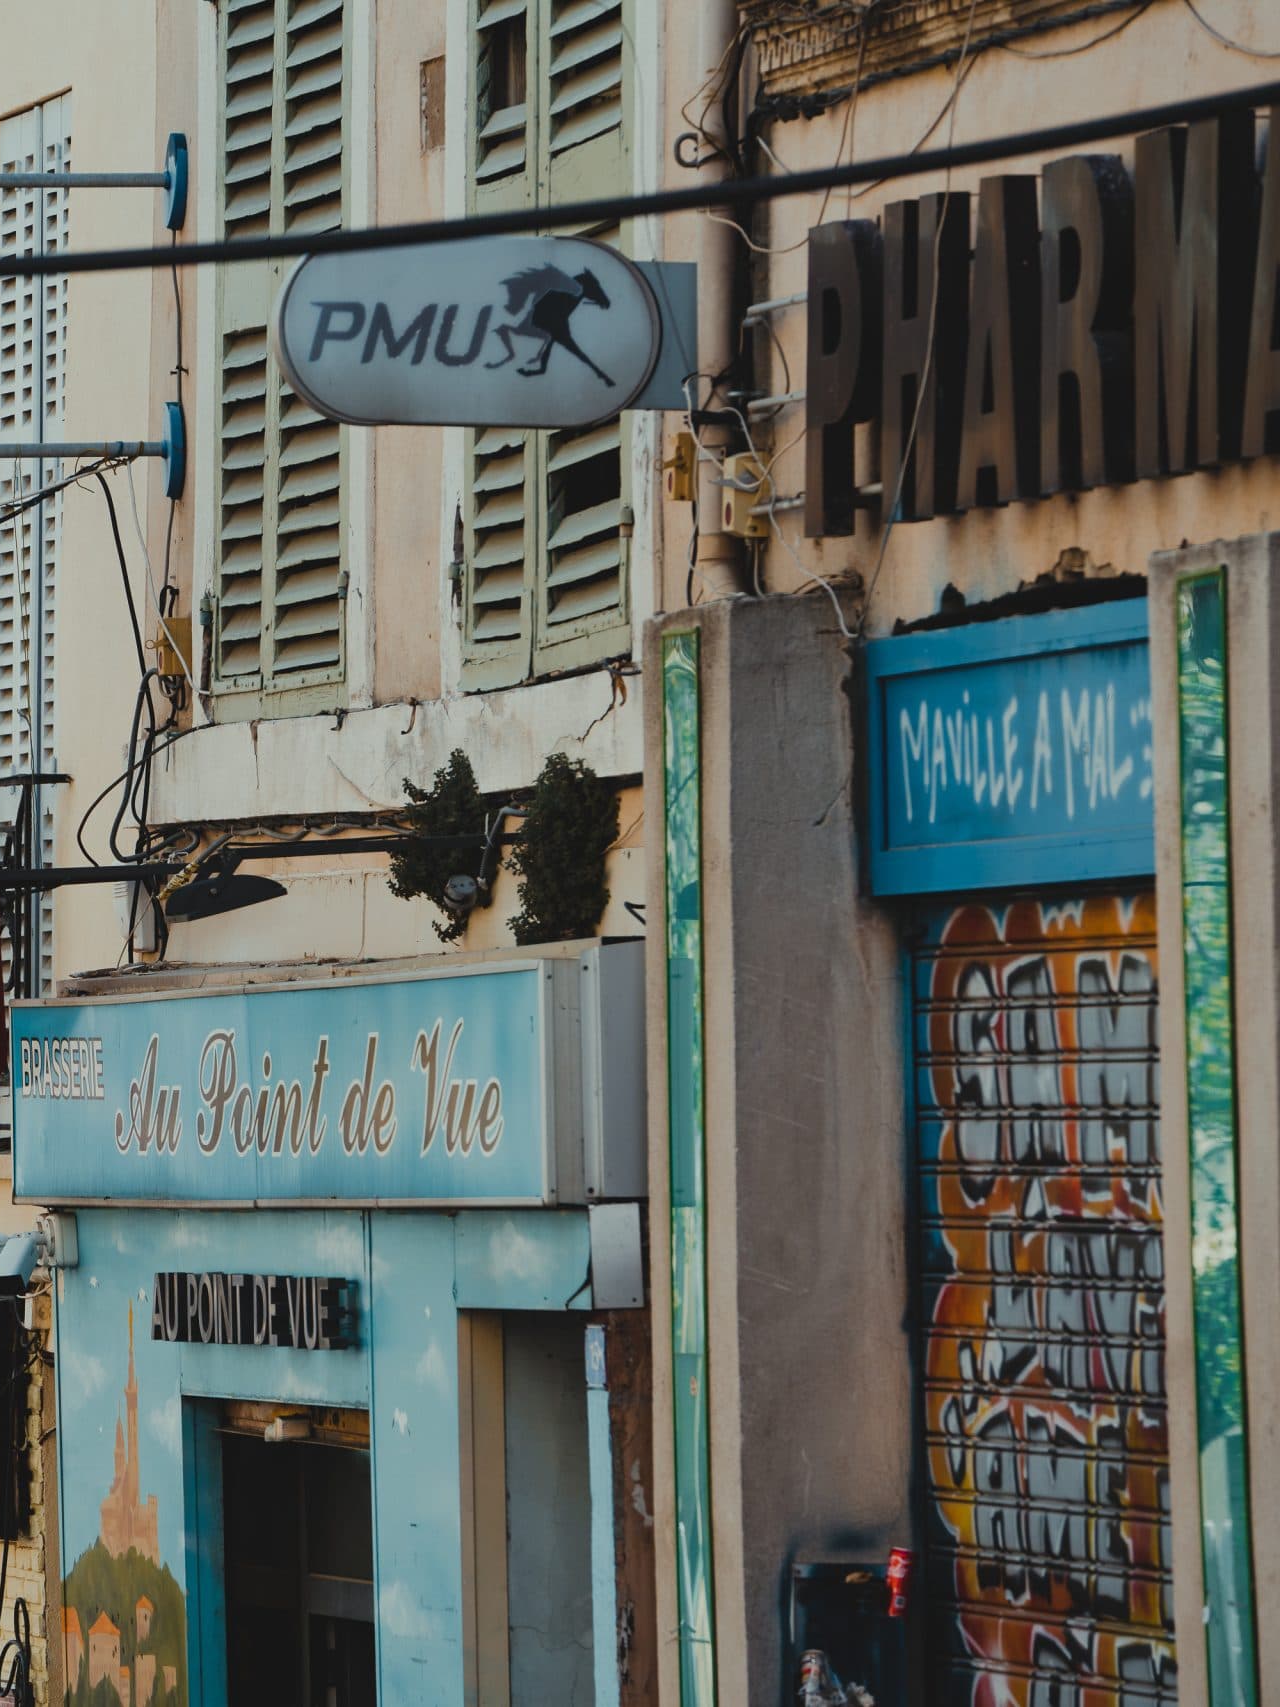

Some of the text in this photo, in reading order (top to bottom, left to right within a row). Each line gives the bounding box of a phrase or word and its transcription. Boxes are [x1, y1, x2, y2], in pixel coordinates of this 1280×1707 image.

[309, 301, 493, 366] PMU
[1030, 691, 1053, 812] A
[21, 1037, 105, 1100] BRASSERIE
[115, 1017, 505, 1157] Au Point de Vue
[152, 1272, 331, 1351] AU POINT DE VUE
